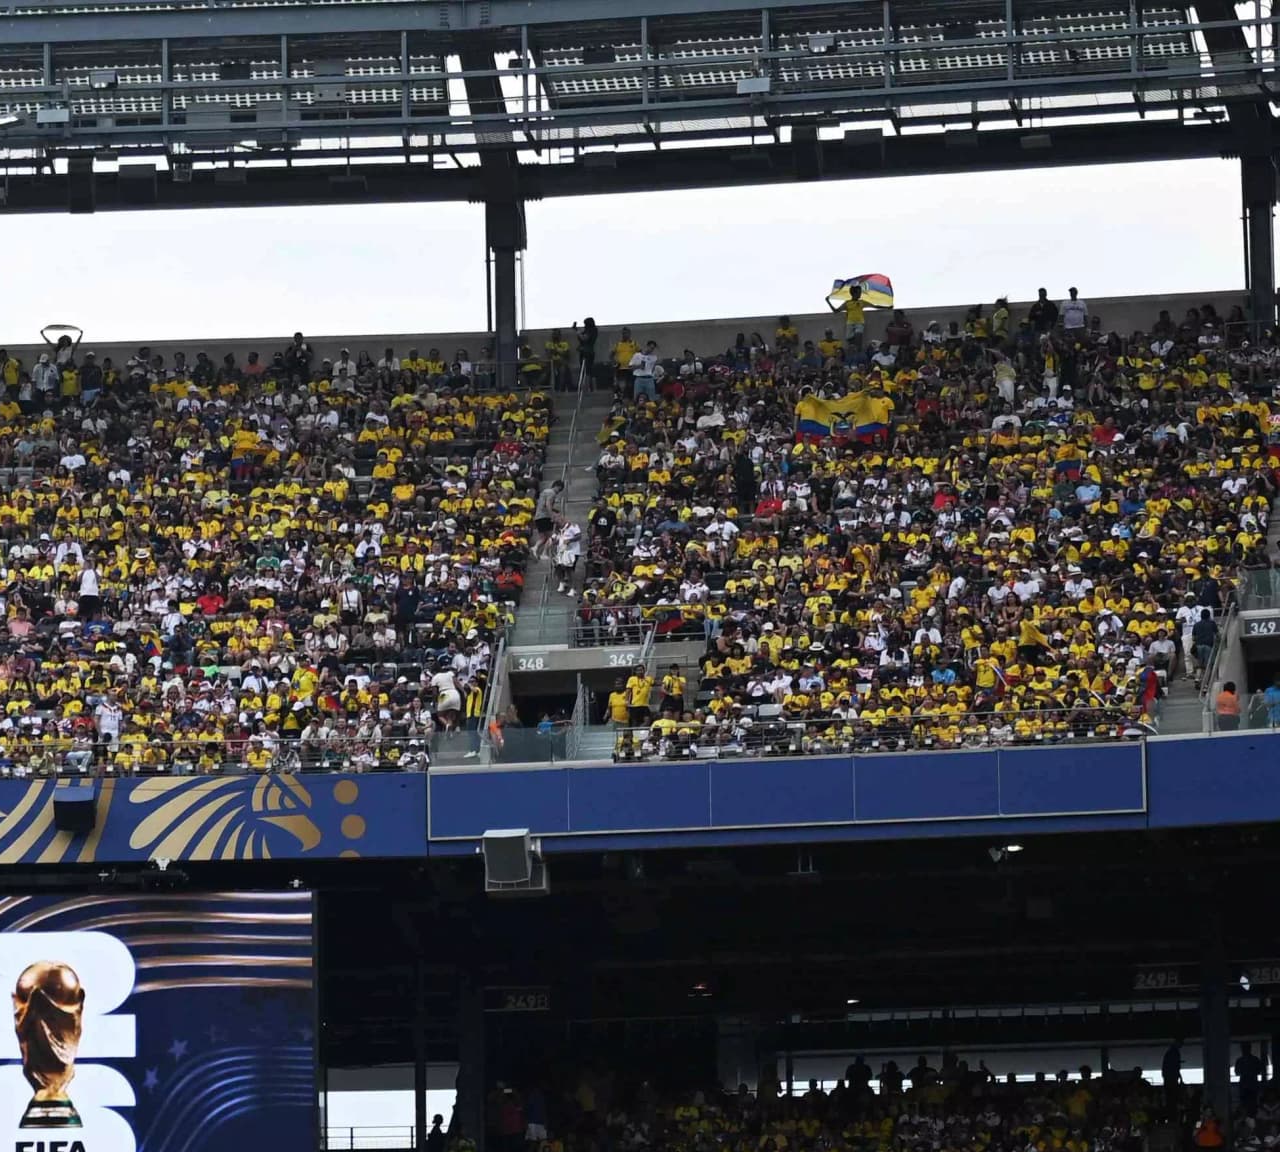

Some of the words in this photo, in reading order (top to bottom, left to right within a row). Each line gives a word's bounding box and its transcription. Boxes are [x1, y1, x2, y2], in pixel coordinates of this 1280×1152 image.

[1249, 621, 1277, 635] 349
[518, 657, 543, 669] 348
[609, 653, 633, 665] 349
